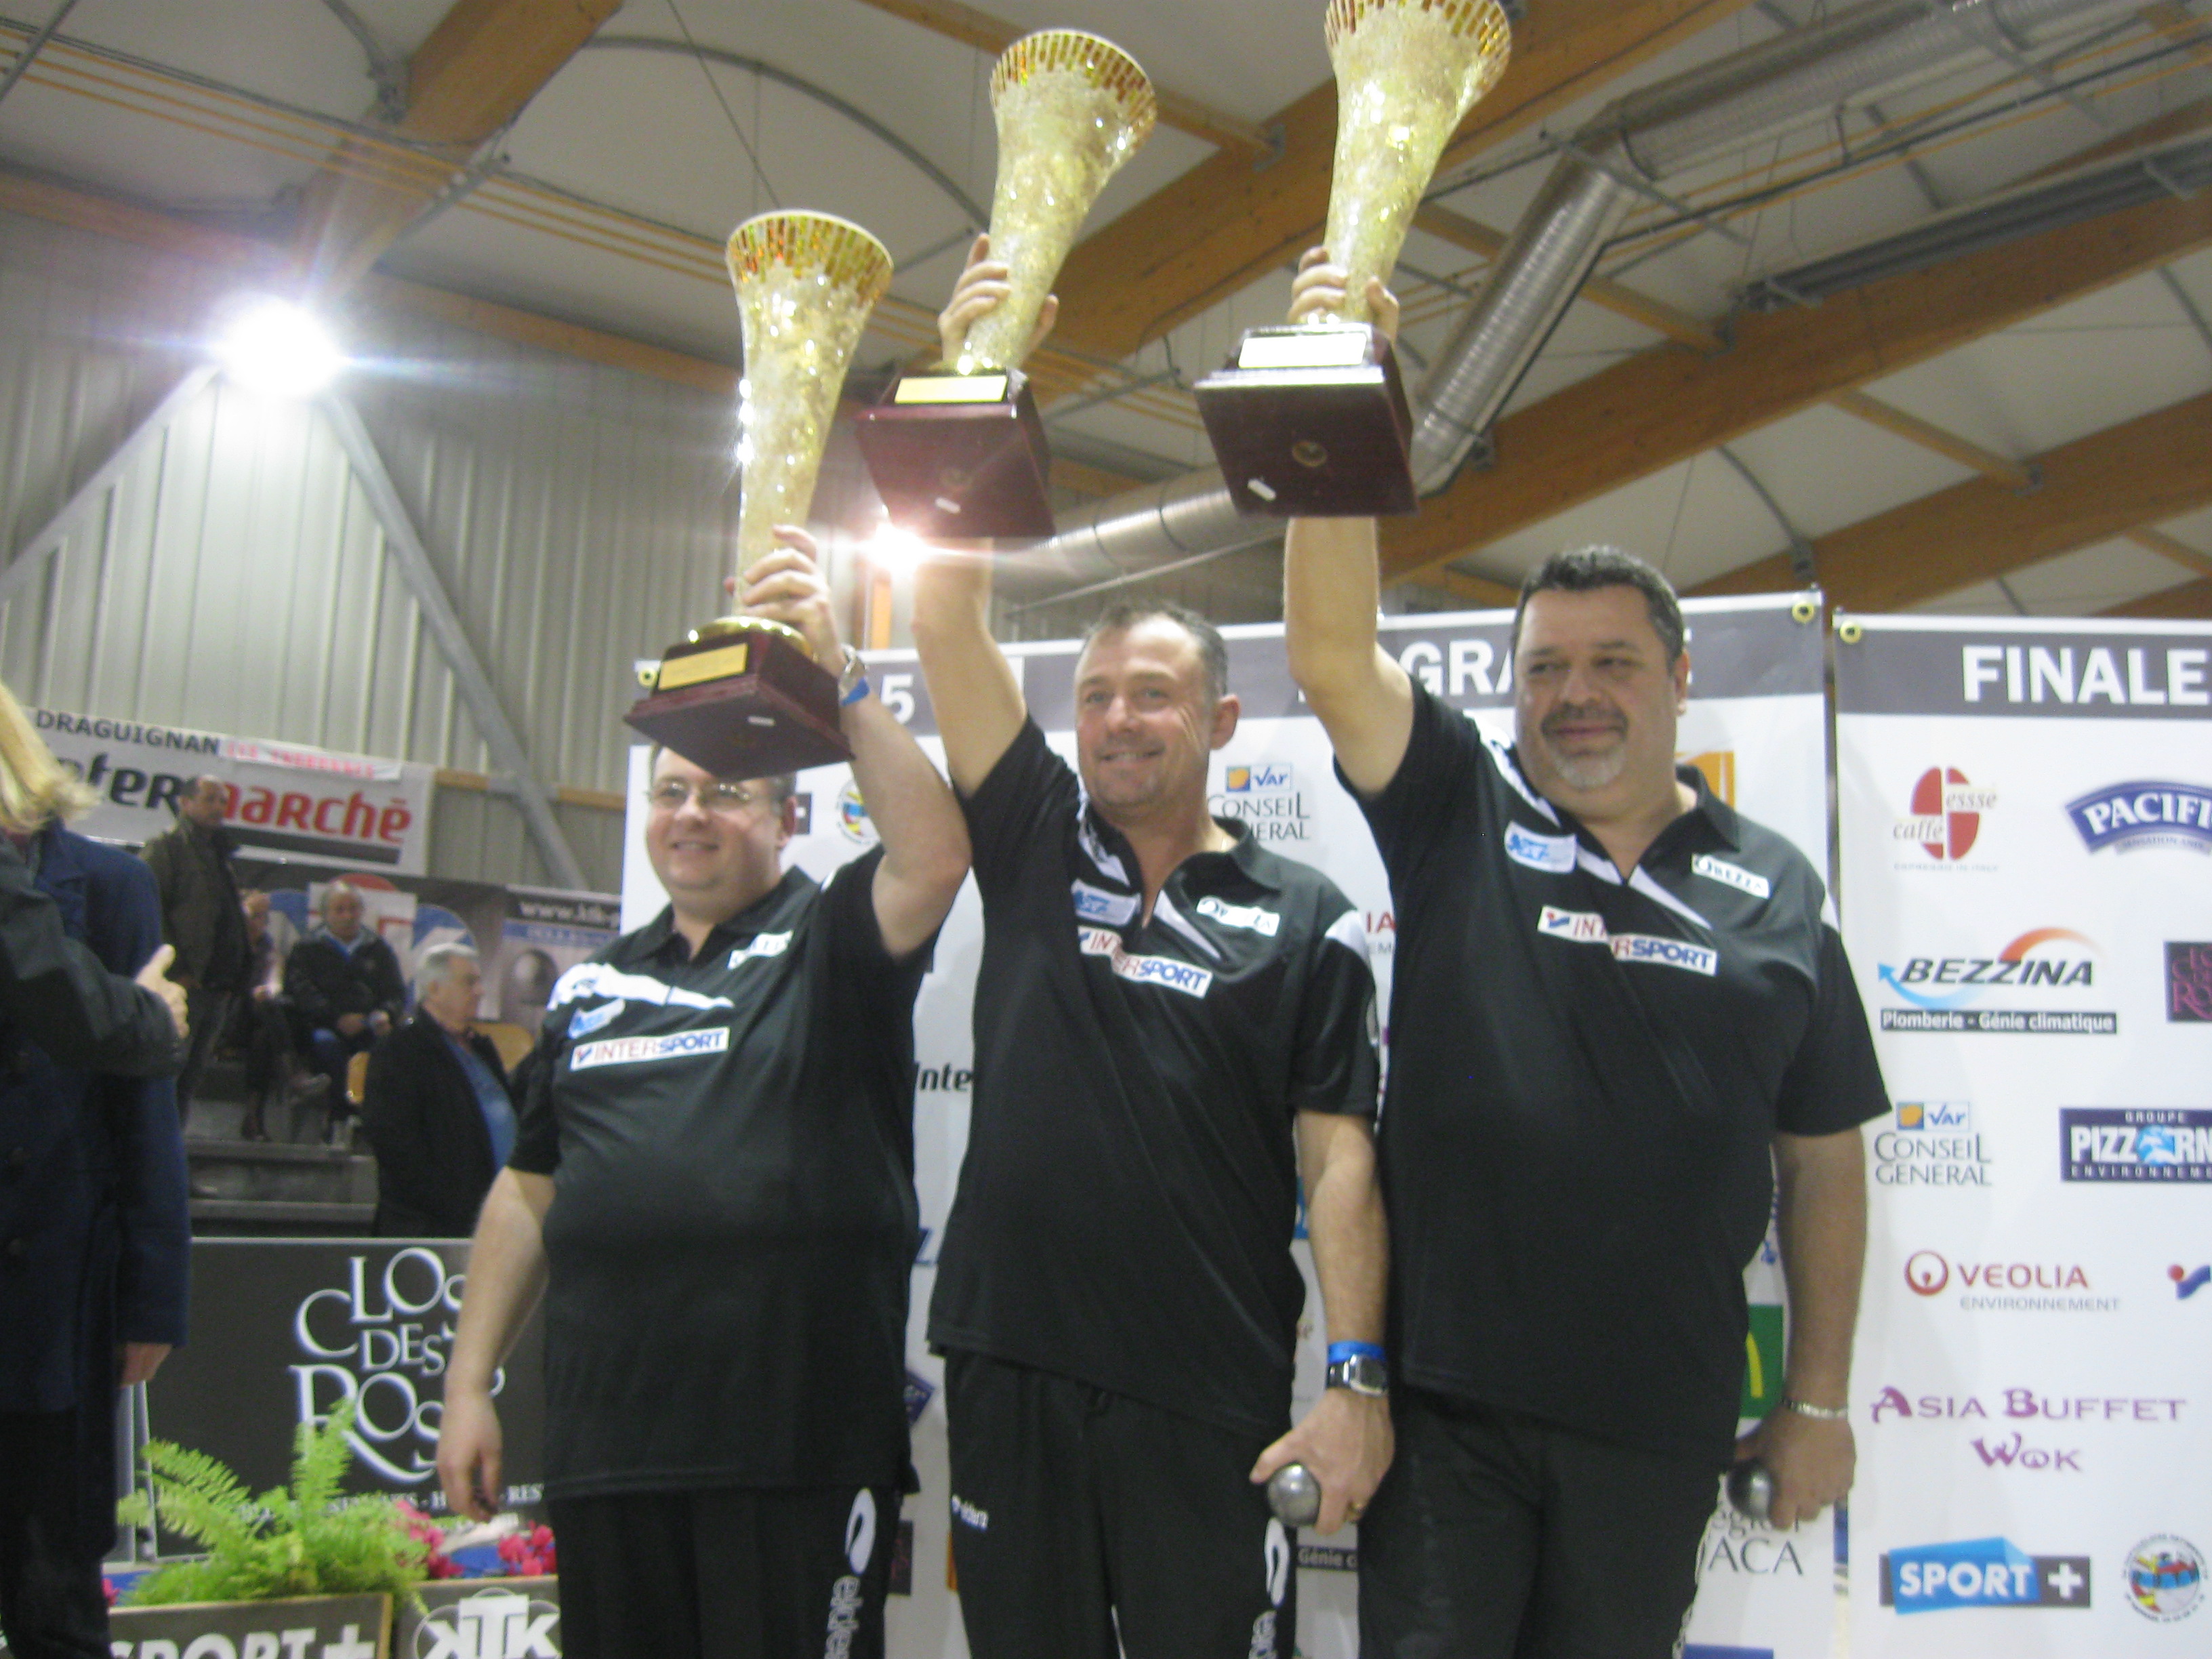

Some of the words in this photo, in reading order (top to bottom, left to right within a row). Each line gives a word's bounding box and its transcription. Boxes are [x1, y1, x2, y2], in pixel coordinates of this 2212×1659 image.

[1963, 646, 2211, 705] FINALE
[37, 709, 220, 754] DRAGUIGNAN
[1250, 821, 1310, 841] ERAL
[1900, 958, 2093, 987] BEZZINA
[594, 1030, 723, 1063] INTERSPORT
[1874, 1132, 1992, 1164] CONSEIL
[1958, 1264, 2089, 1288] VEOLIA
[1960, 1296, 2119, 1311] ENVIRONNEMENT
[361, 1323, 447, 1377] DES
[1898, 1562, 2032, 1599] SPORT
